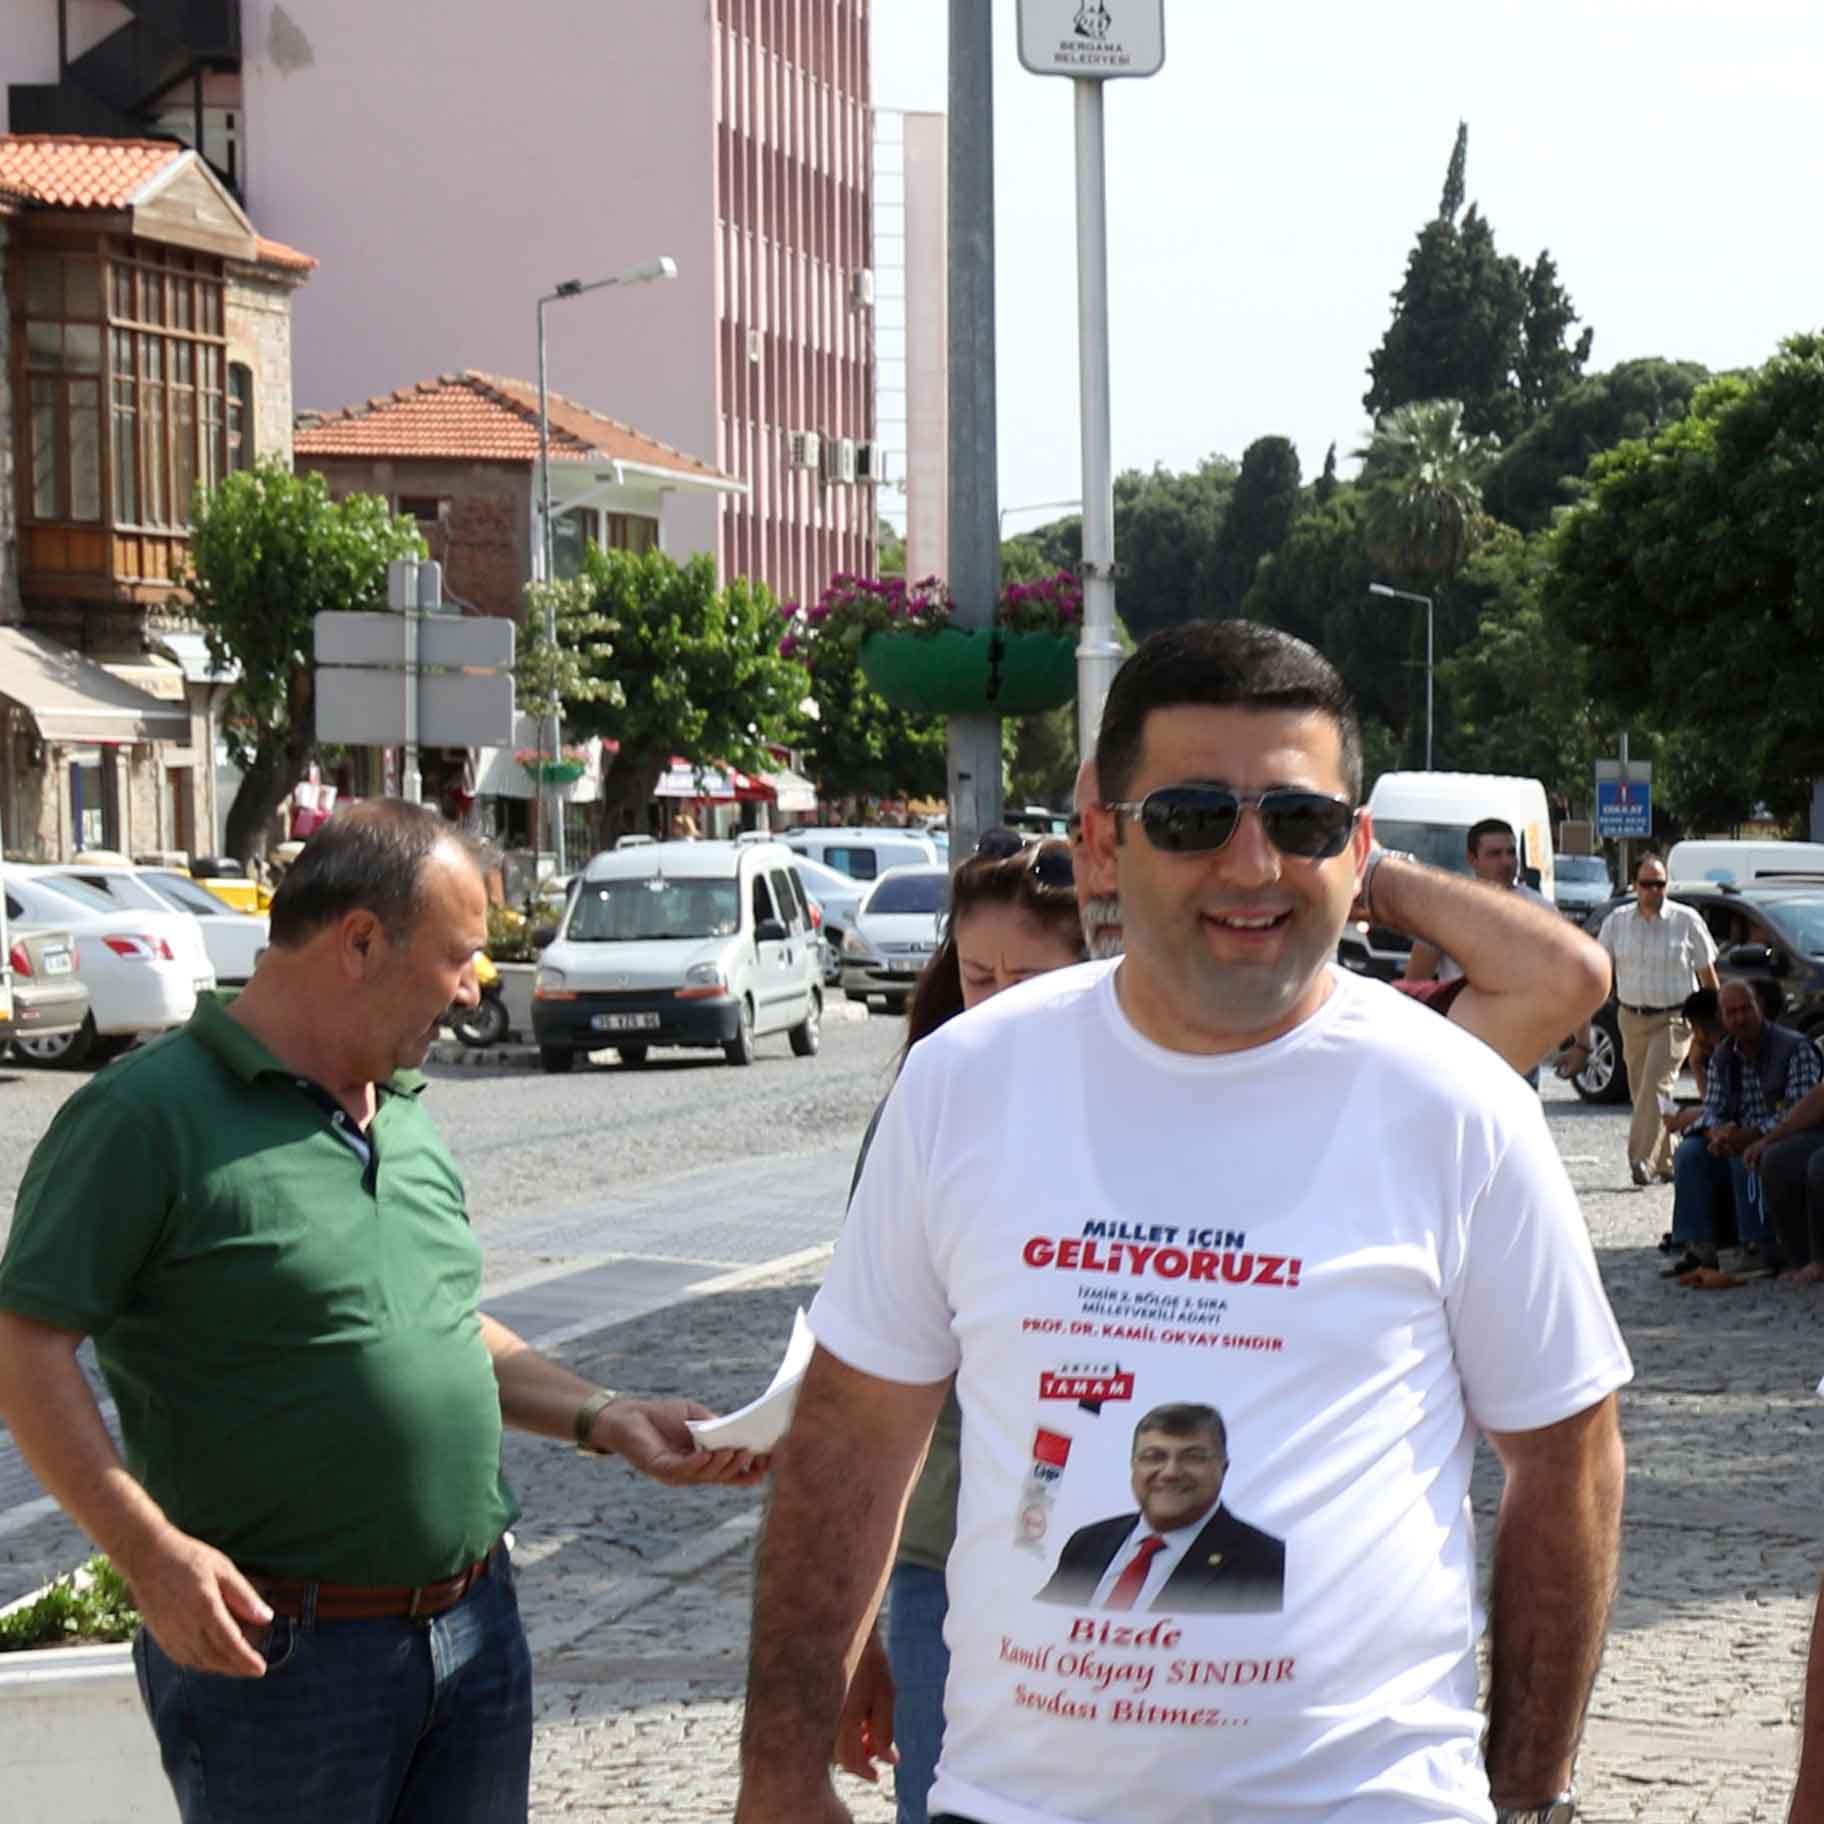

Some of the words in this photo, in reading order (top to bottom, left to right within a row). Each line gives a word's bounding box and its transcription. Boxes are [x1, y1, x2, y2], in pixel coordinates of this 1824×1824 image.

[1059, 41, 1122, 52] BERGAMA
[1082, 1218, 1179, 1245] MİLLET
[1023, 1236, 1302, 1287] GELİYORUZ!
[1022, 1317, 1067, 1336] PROF.
[1070, 1321, 1098, 1338] DR.
[1101, 1321, 1157, 1343] KAMİL
[1160, 1328, 1218, 1347] OKYAY
[1221, 1334, 1284, 1352] SINDIR
[1044, 1379, 1125, 1396] TAMAM
[1069, 1615, 1182, 1648] Bizde
[999, 1635, 1055, 1672] Kamil
[1056, 1649, 1155, 1694] Okyay
[1166, 1656, 1297, 1685] SINDIR
